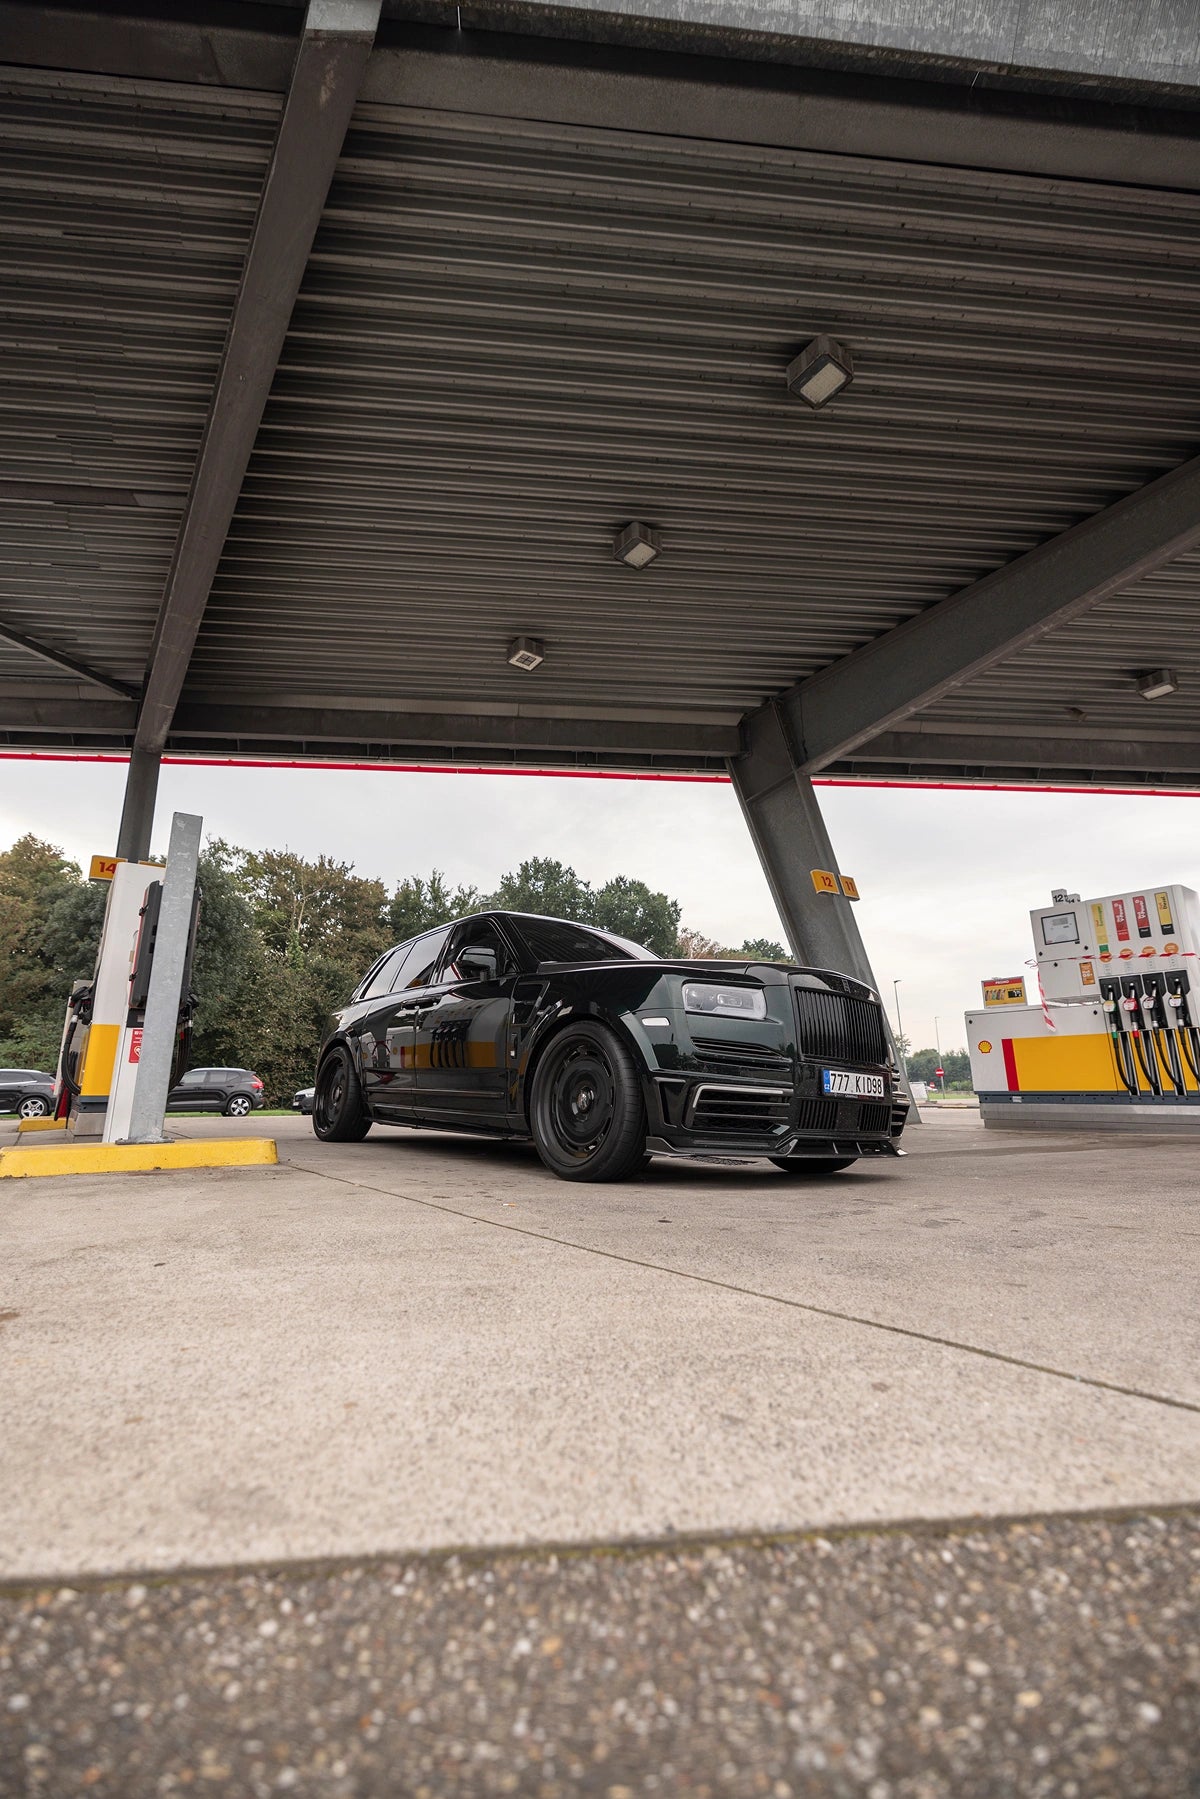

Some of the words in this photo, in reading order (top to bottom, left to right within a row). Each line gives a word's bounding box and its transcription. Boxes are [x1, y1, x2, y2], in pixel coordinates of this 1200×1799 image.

[99, 861, 117, 874] 14
[820, 875, 833, 887] 12
[1053, 894, 1064, 903] 12
[831, 1073, 849, 1091] 777
[855, 1075, 882, 1094] KID98
